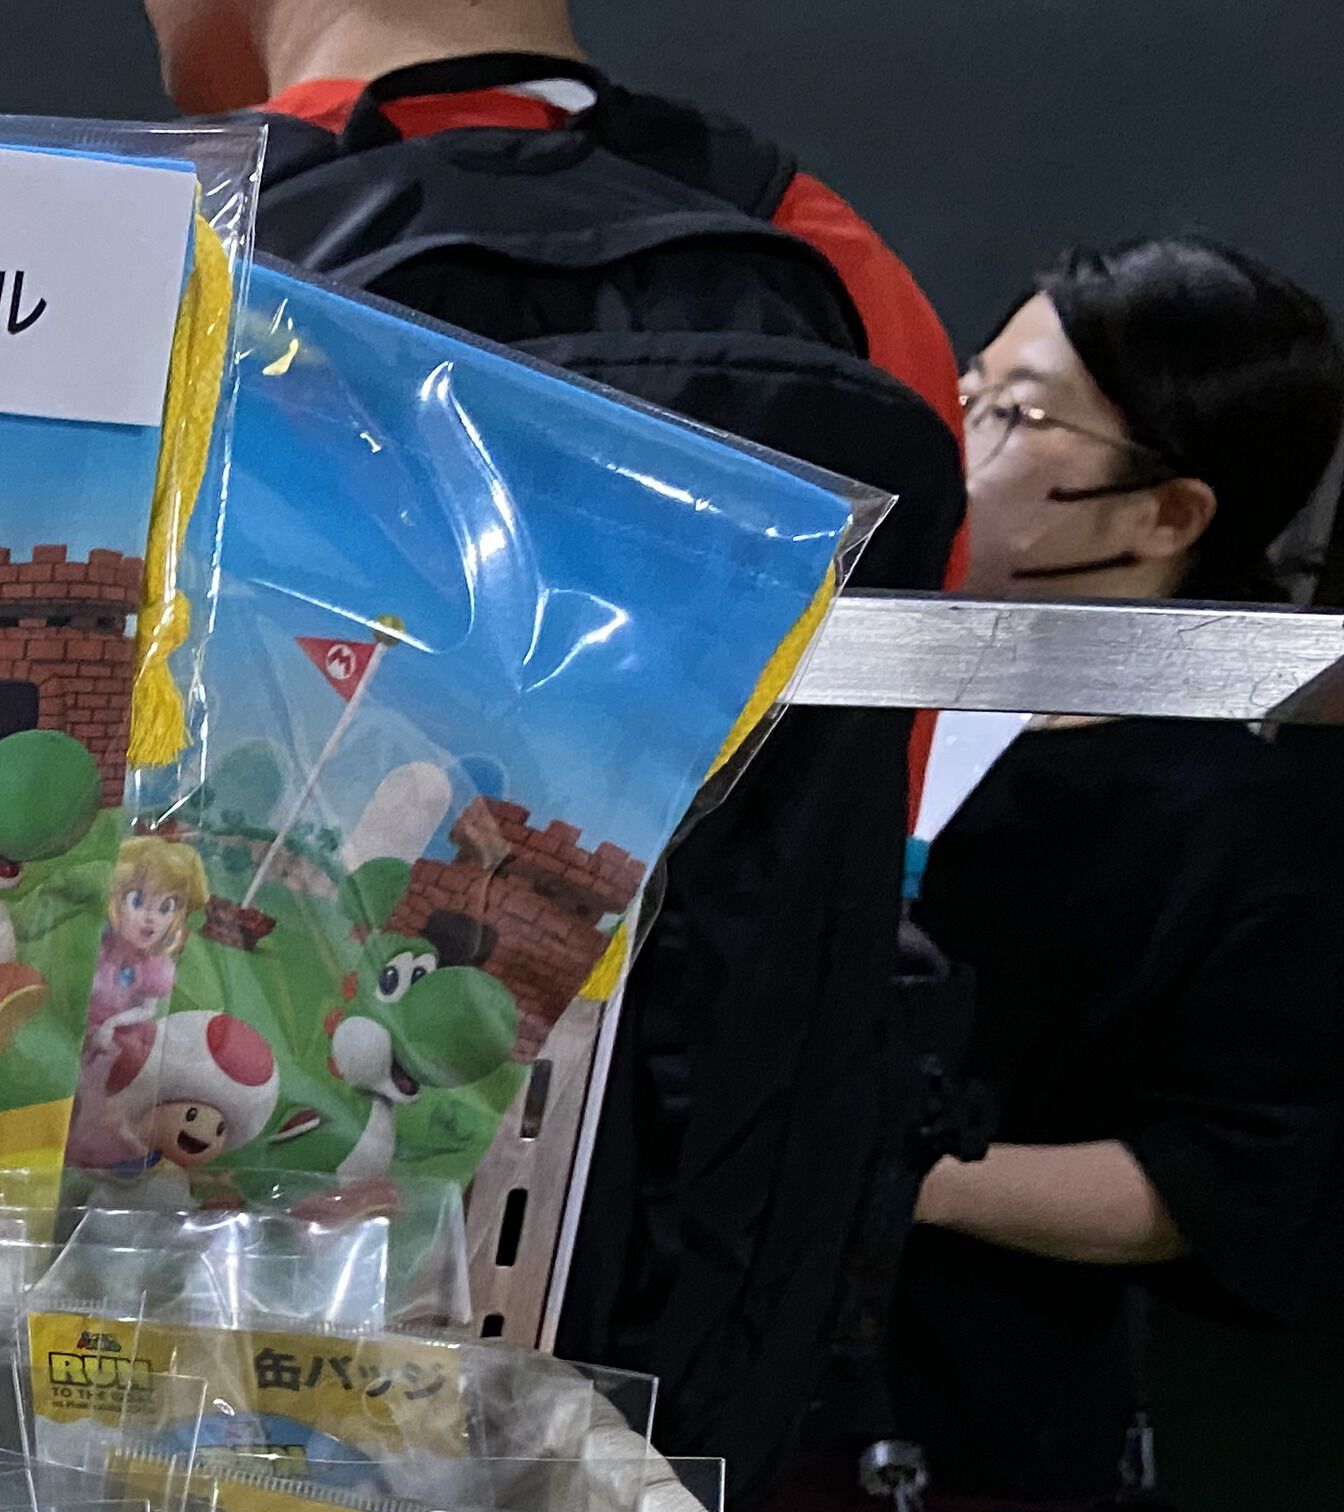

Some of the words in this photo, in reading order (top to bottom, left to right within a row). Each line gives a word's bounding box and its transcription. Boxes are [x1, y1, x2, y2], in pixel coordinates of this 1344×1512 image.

[49, 1351, 153, 1393] RUN
[254, 1348, 446, 1400] 缶バッジ
